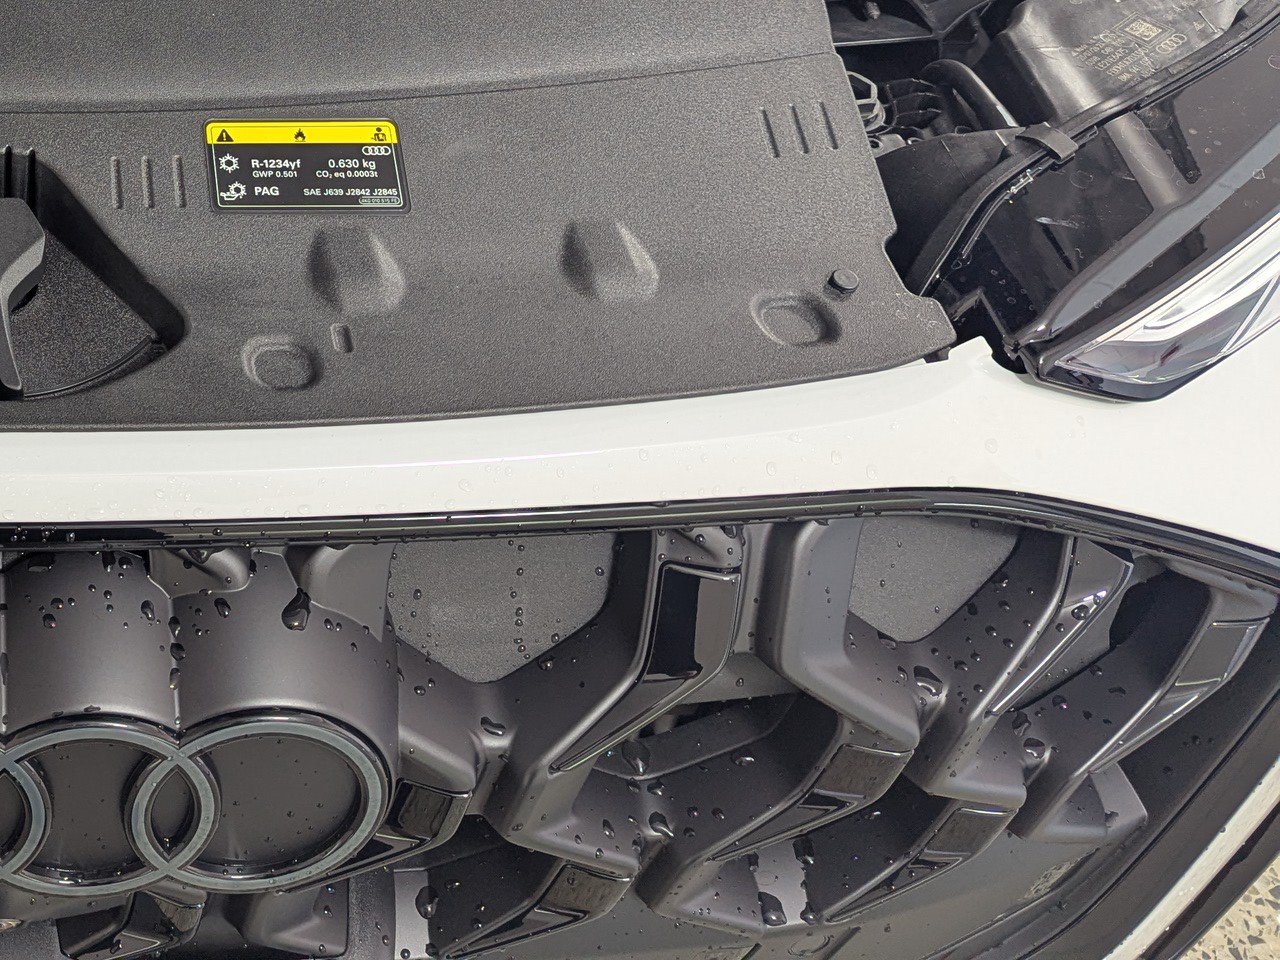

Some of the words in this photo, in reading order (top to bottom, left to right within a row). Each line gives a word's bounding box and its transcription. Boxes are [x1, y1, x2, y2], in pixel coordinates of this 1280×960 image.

[251, 159, 301, 170] R-1234yf
[328, 159, 359, 168] 0.630
[363, 159, 376, 170] kg
[254, 187, 279, 195] PAG
